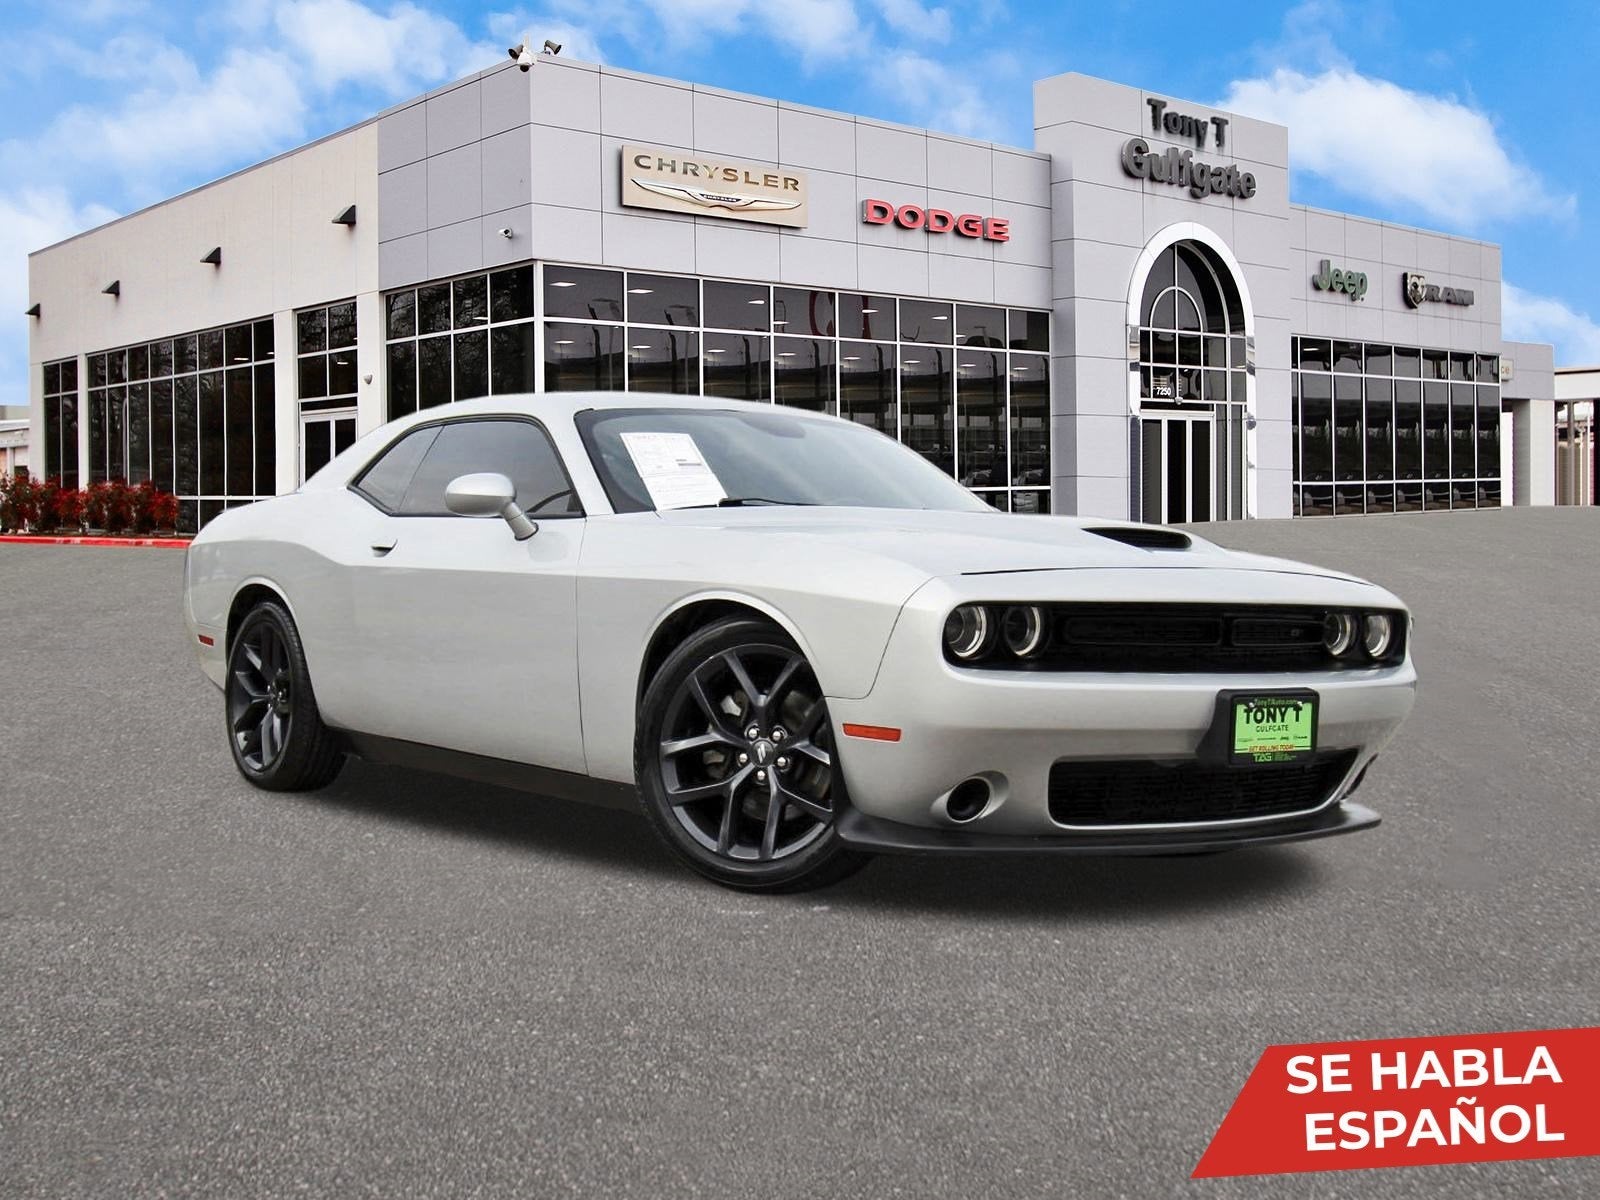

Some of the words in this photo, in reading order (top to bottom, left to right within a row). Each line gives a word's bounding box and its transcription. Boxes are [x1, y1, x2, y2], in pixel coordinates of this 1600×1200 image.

[1147, 98, 1208, 148] Tony
[1211, 117, 1229, 148] T
[633, 154, 800, 192] CHRYSLER
[1121, 138, 1256, 199] Gulfgate
[862, 199, 1010, 242] DODGE
[1312, 259, 1368, 301] Jeep
[1424, 283, 1475, 306] RAM
[1156, 386, 1171, 396] 7250
[1244, 705, 1289, 724] TONY
[1293, 705, 1302, 722] T
